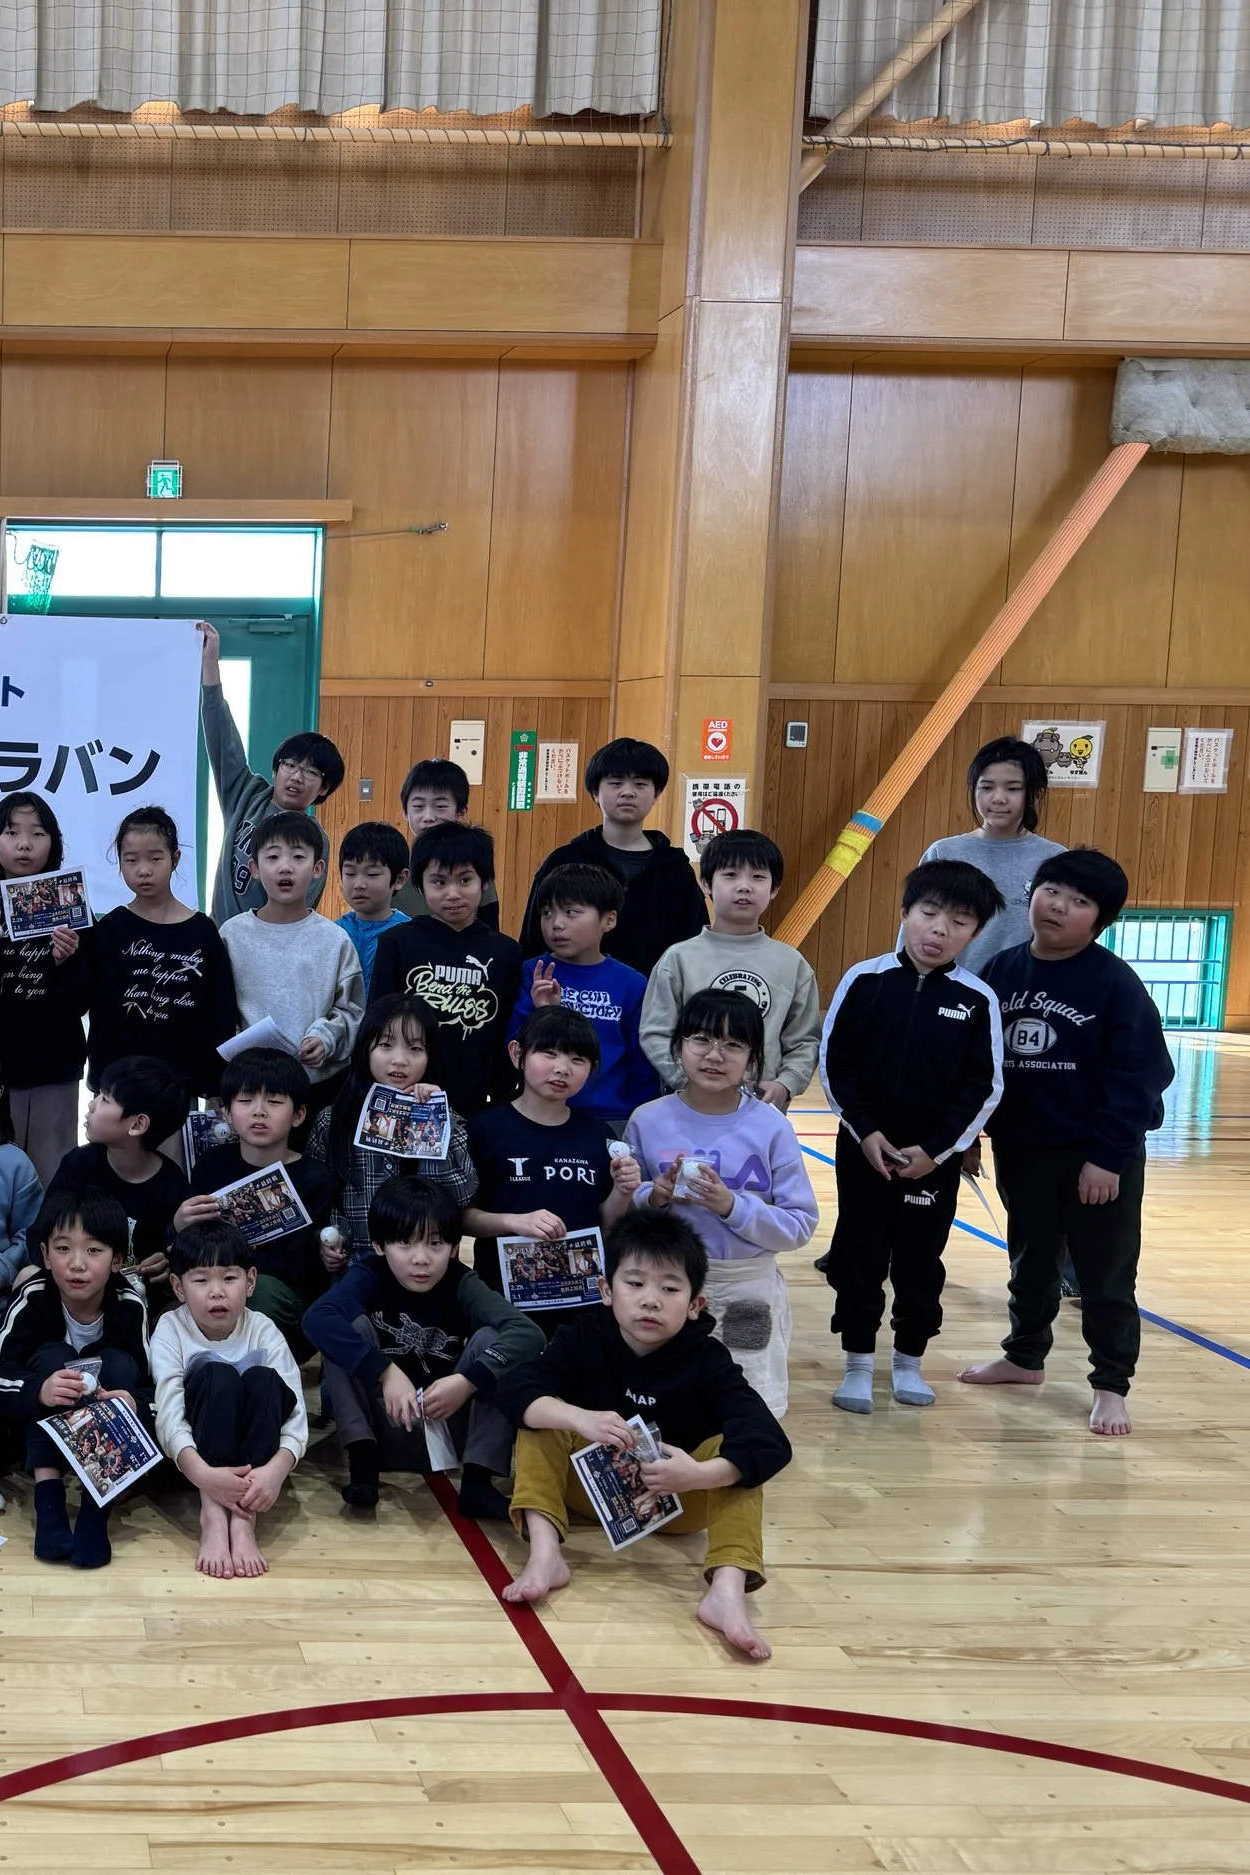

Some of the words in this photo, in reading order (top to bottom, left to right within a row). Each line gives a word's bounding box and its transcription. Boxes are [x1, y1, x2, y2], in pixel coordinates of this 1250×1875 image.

[708, 720, 728, 729] AED
[19, 943, 50, 962] happi
[121, 939, 165, 963] Nothing
[170, 949, 203, 963] makes
[133, 968, 149, 976] me
[151, 964, 189, 985] happier
[413, 970, 459, 994] Bend
[455, 983, 472, 996] the
[434, 964, 482, 986] PUMA
[718, 973, 763, 988] CELEBRATING
[14, 985, 24, 995] to
[27, 987, 46, 1000] you
[124, 984, 149, 998] than
[173, 992, 195, 1007] close
[413, 992, 490, 1021] RULES
[938, 1007, 967, 1021] PUMA
[1001, 990, 1029, 1013] eld
[1030, 991, 1097, 1027] Squad
[1017, 1030, 1040, 1046] 84
[1018, 1060, 1077, 1070] ASSOCIATION
[544, 1166, 596, 1185] PORT
[904, 1194, 931, 1205] PUMA
